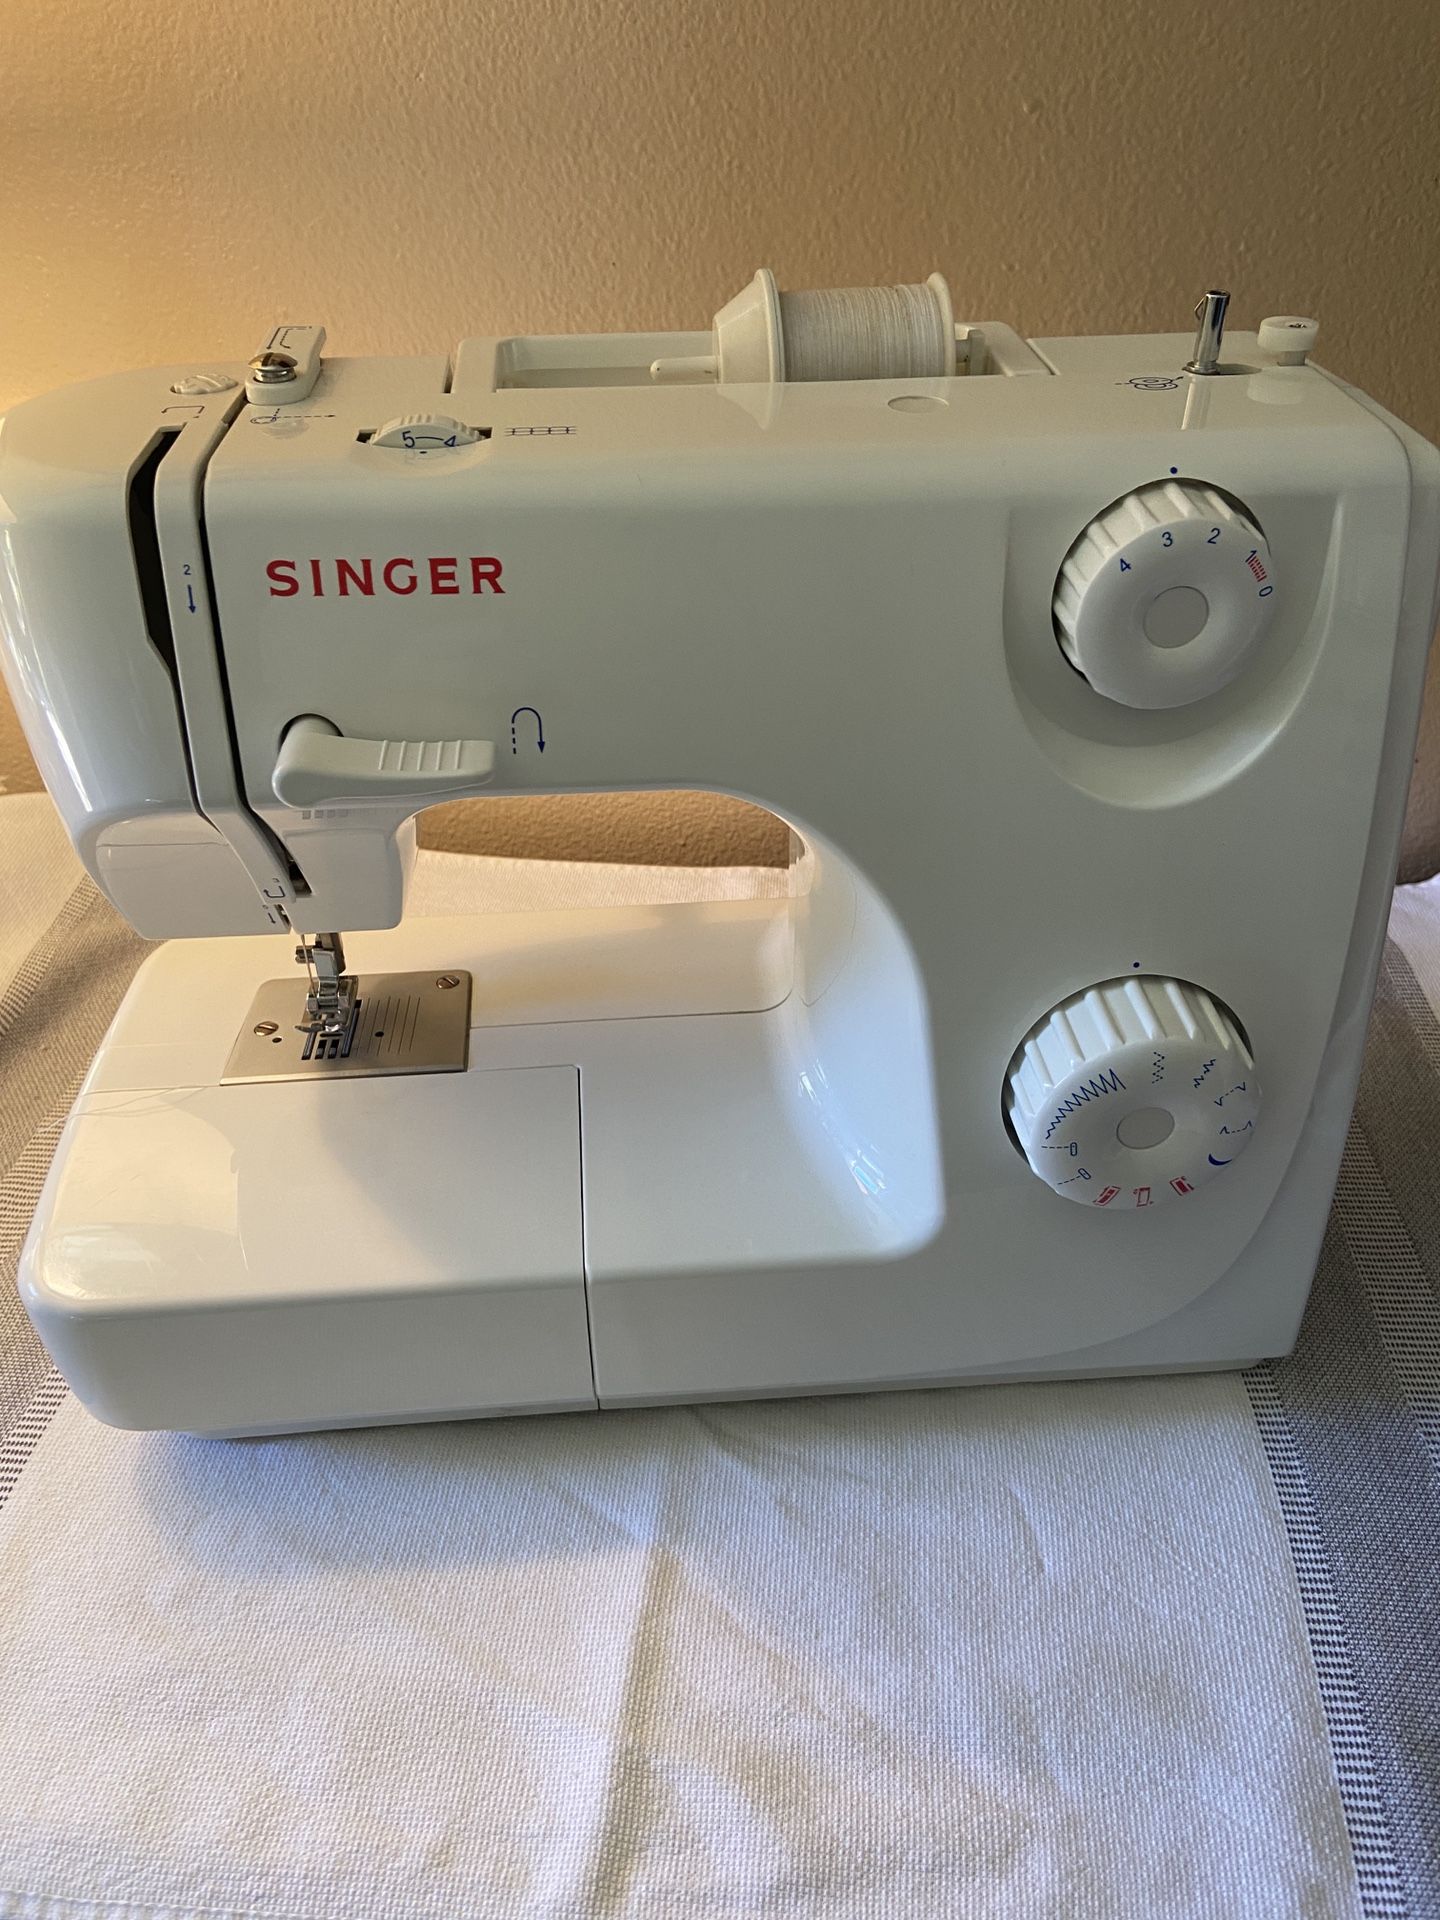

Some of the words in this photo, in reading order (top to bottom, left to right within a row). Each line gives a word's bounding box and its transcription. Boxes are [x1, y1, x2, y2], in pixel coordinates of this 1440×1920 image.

[402, 430, 415, 448] 5
[183, 564, 192, 576] 2
[266, 556, 506, 597] SINGER
[1119, 558, 1132, 572] 4
[1161, 531, 1173, 547] 3
[1207, 527, 1221, 544] 2
[1244, 549, 1258, 564] 1
[1258, 585, 1273, 598] 0
